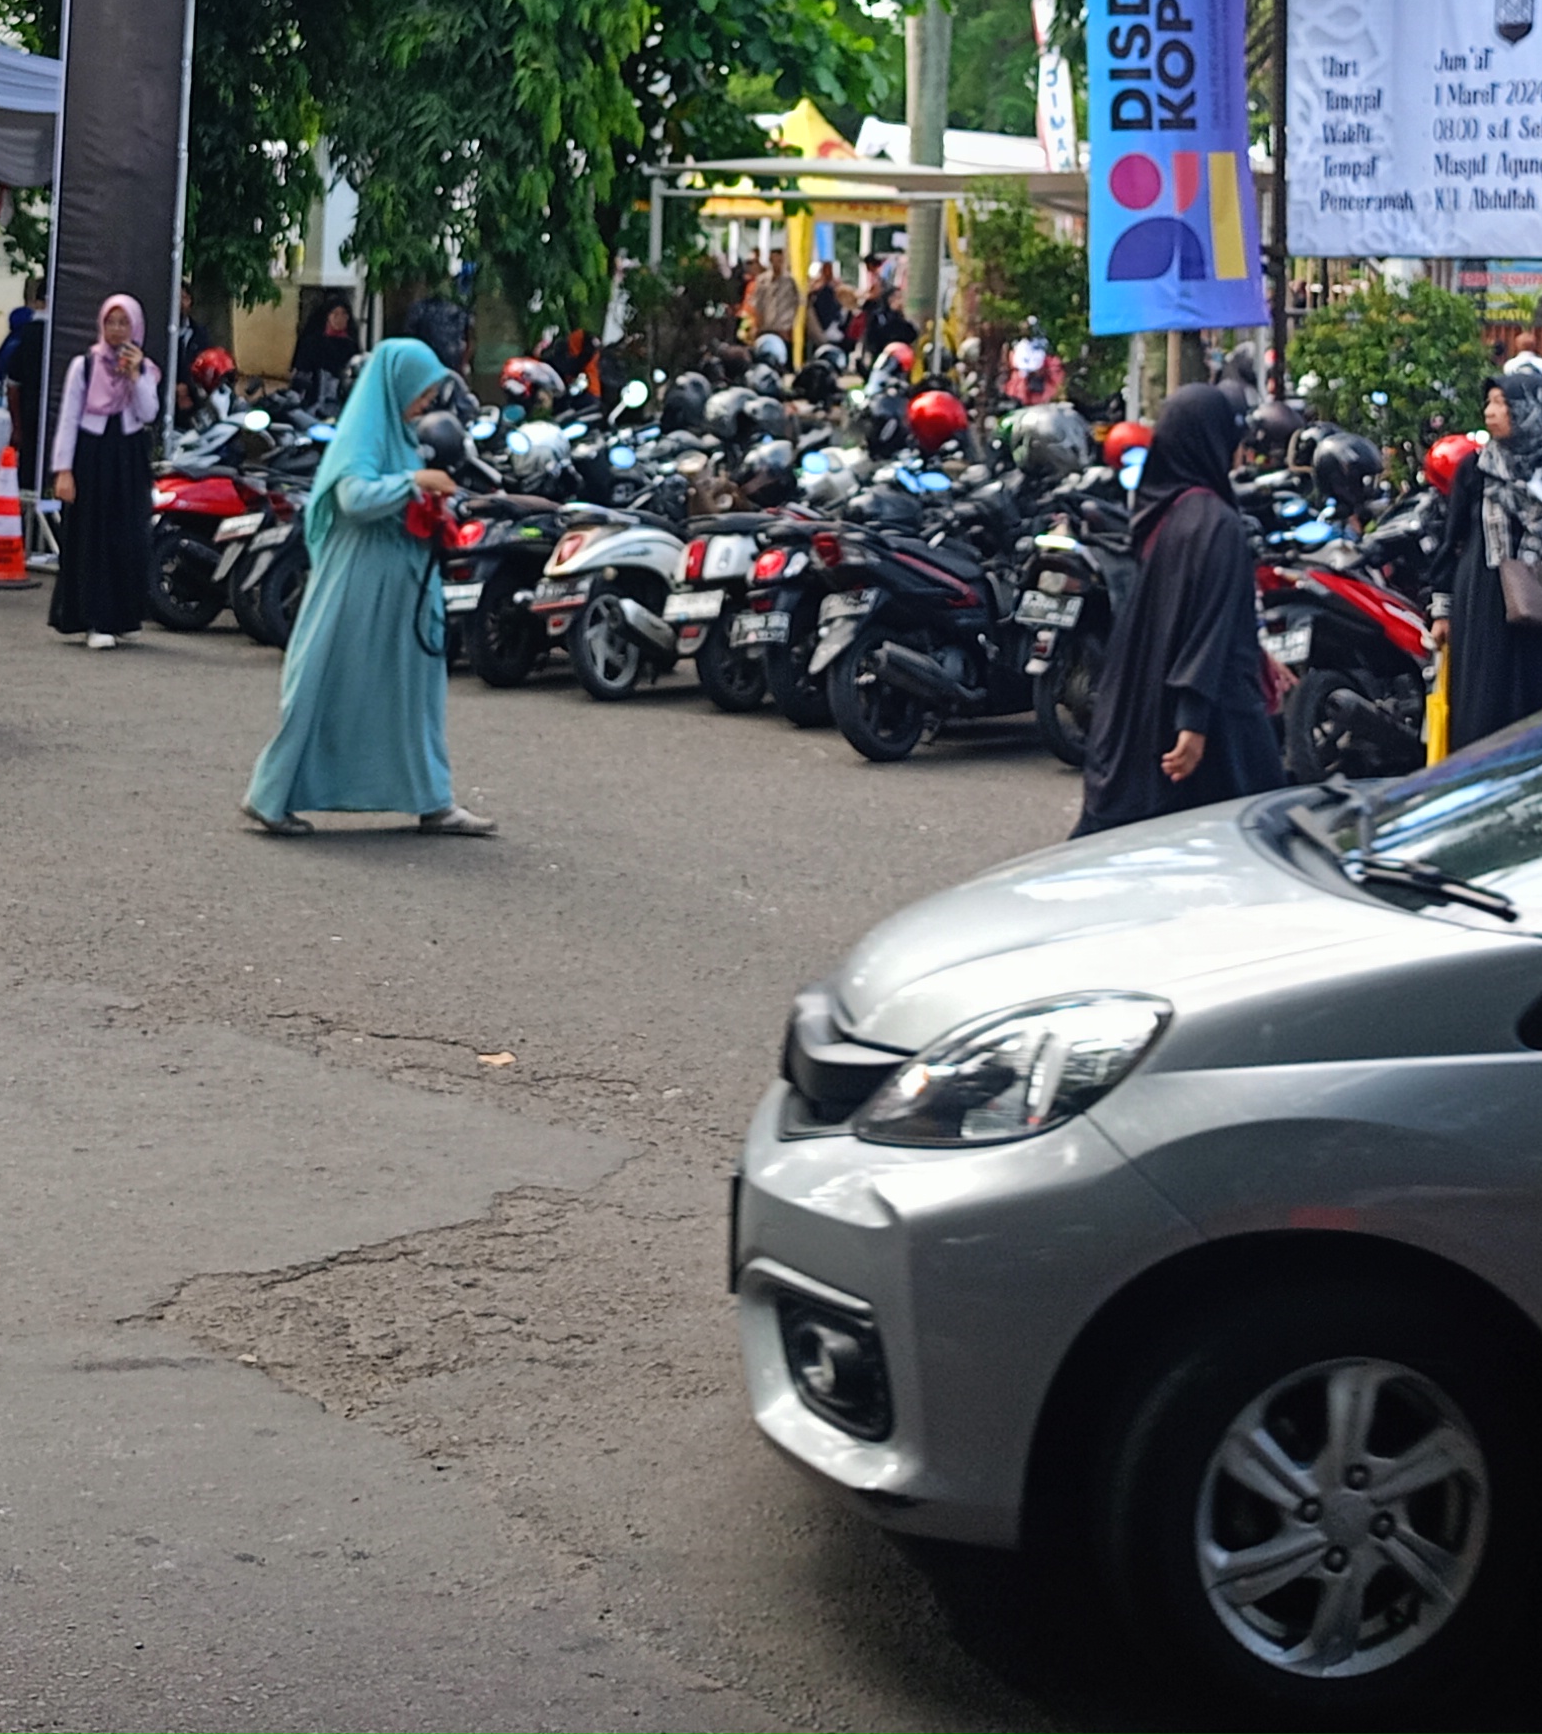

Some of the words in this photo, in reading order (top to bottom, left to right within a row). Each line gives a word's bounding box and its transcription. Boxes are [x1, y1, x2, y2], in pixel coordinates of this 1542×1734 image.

[1324, 89, 1382, 114] Tanggal
[1447, 82, 1499, 107] Maret
[1434, 153, 1487, 180] Masjid
[1320, 189, 1415, 212] Penceramah
[1469, 186, 1535, 212] Abdullah
